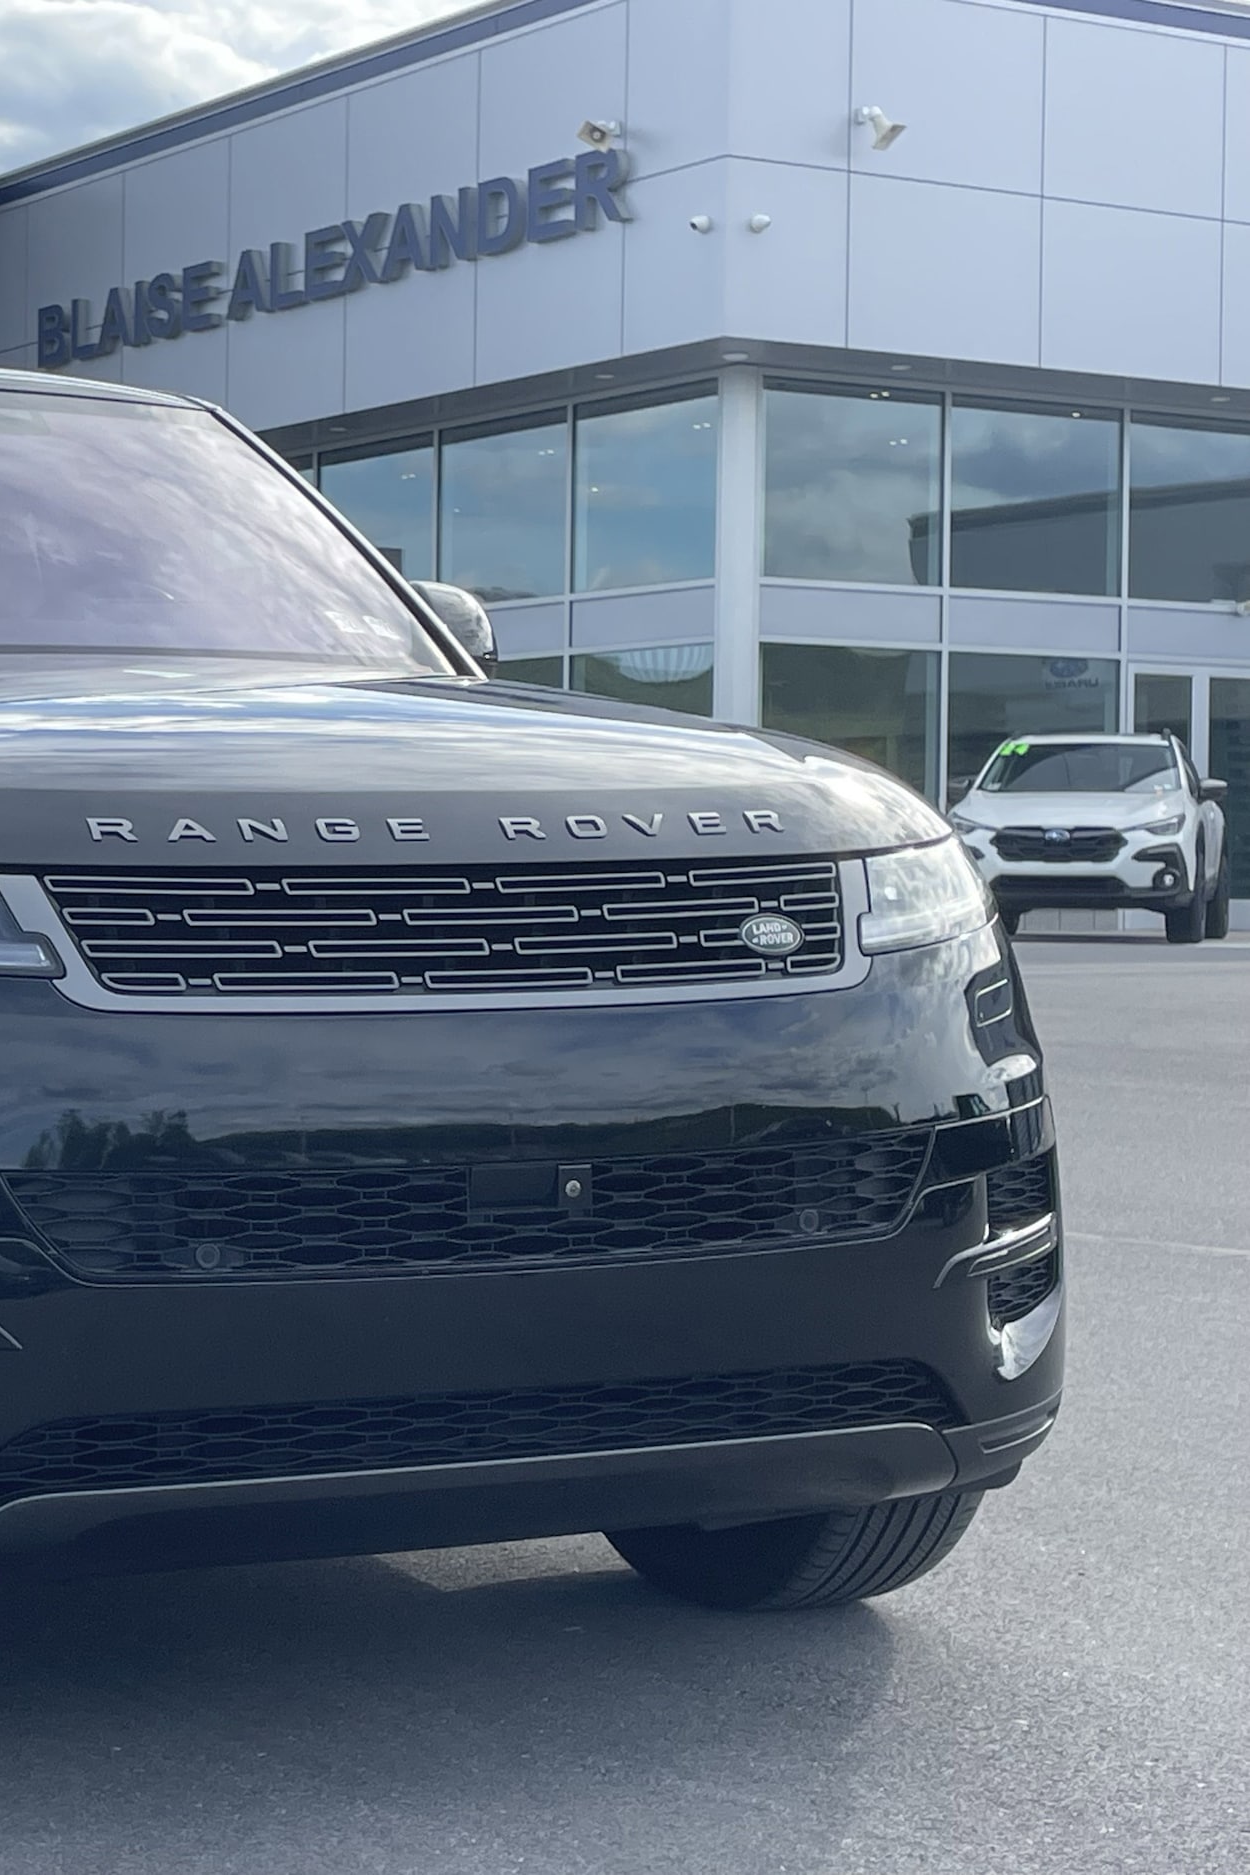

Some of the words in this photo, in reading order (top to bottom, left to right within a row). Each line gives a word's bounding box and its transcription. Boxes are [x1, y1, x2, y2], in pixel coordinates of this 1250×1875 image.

[37, 259, 224, 369] BLAISE
[226, 149, 633, 321] ALEXANDER
[86, 817, 430, 842] RANGE
[498, 810, 785, 840] ROVER
[751, 922, 782, 935] LAND
[759, 932, 794, 946] ROVER
